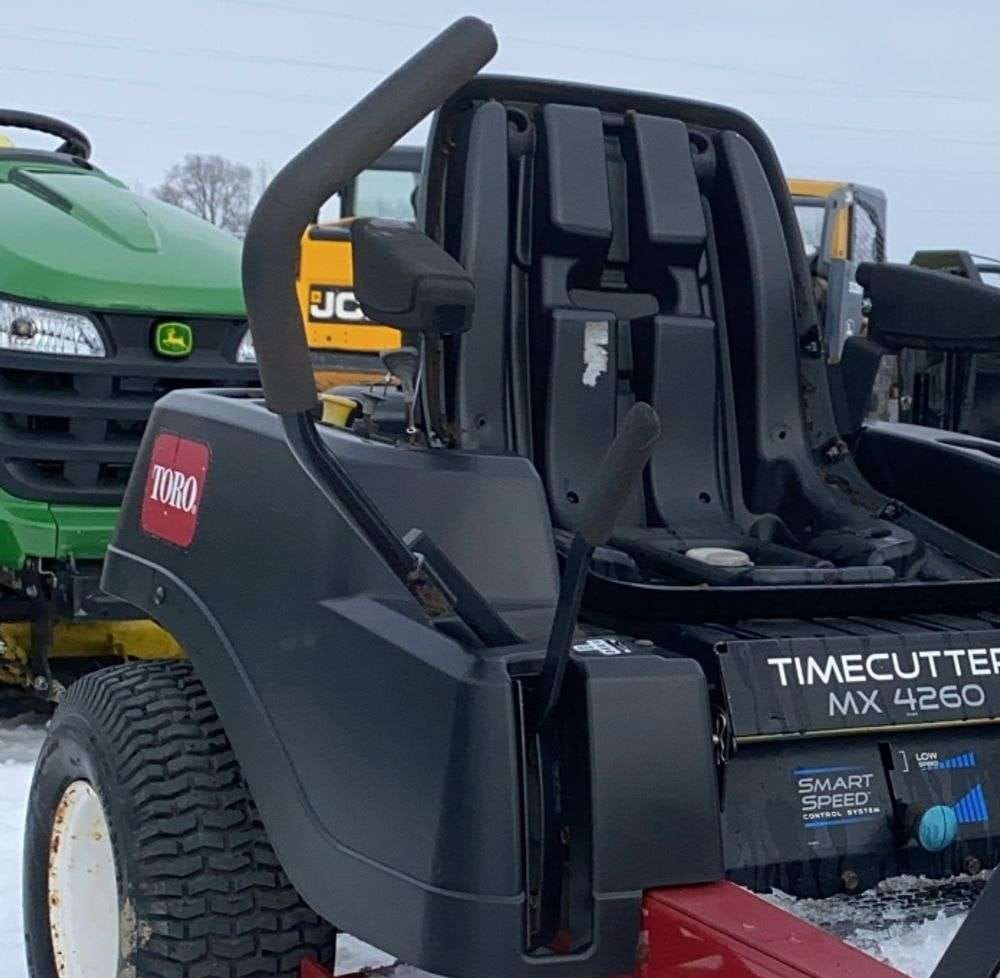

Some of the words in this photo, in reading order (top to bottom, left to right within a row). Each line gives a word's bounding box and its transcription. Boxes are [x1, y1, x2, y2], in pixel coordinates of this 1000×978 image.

[310, 291, 369, 320] JC
[150, 464, 197, 513] TORO
[829, 689, 883, 716] MX
[894, 684, 985, 712] 4260
[916, 752, 937, 761] LOW
[798, 774, 874, 793] SMART
[802, 792, 871, 811] SPEED
[803, 811, 842, 820] CONTROL
[847, 807, 880, 816] SYSTEM
